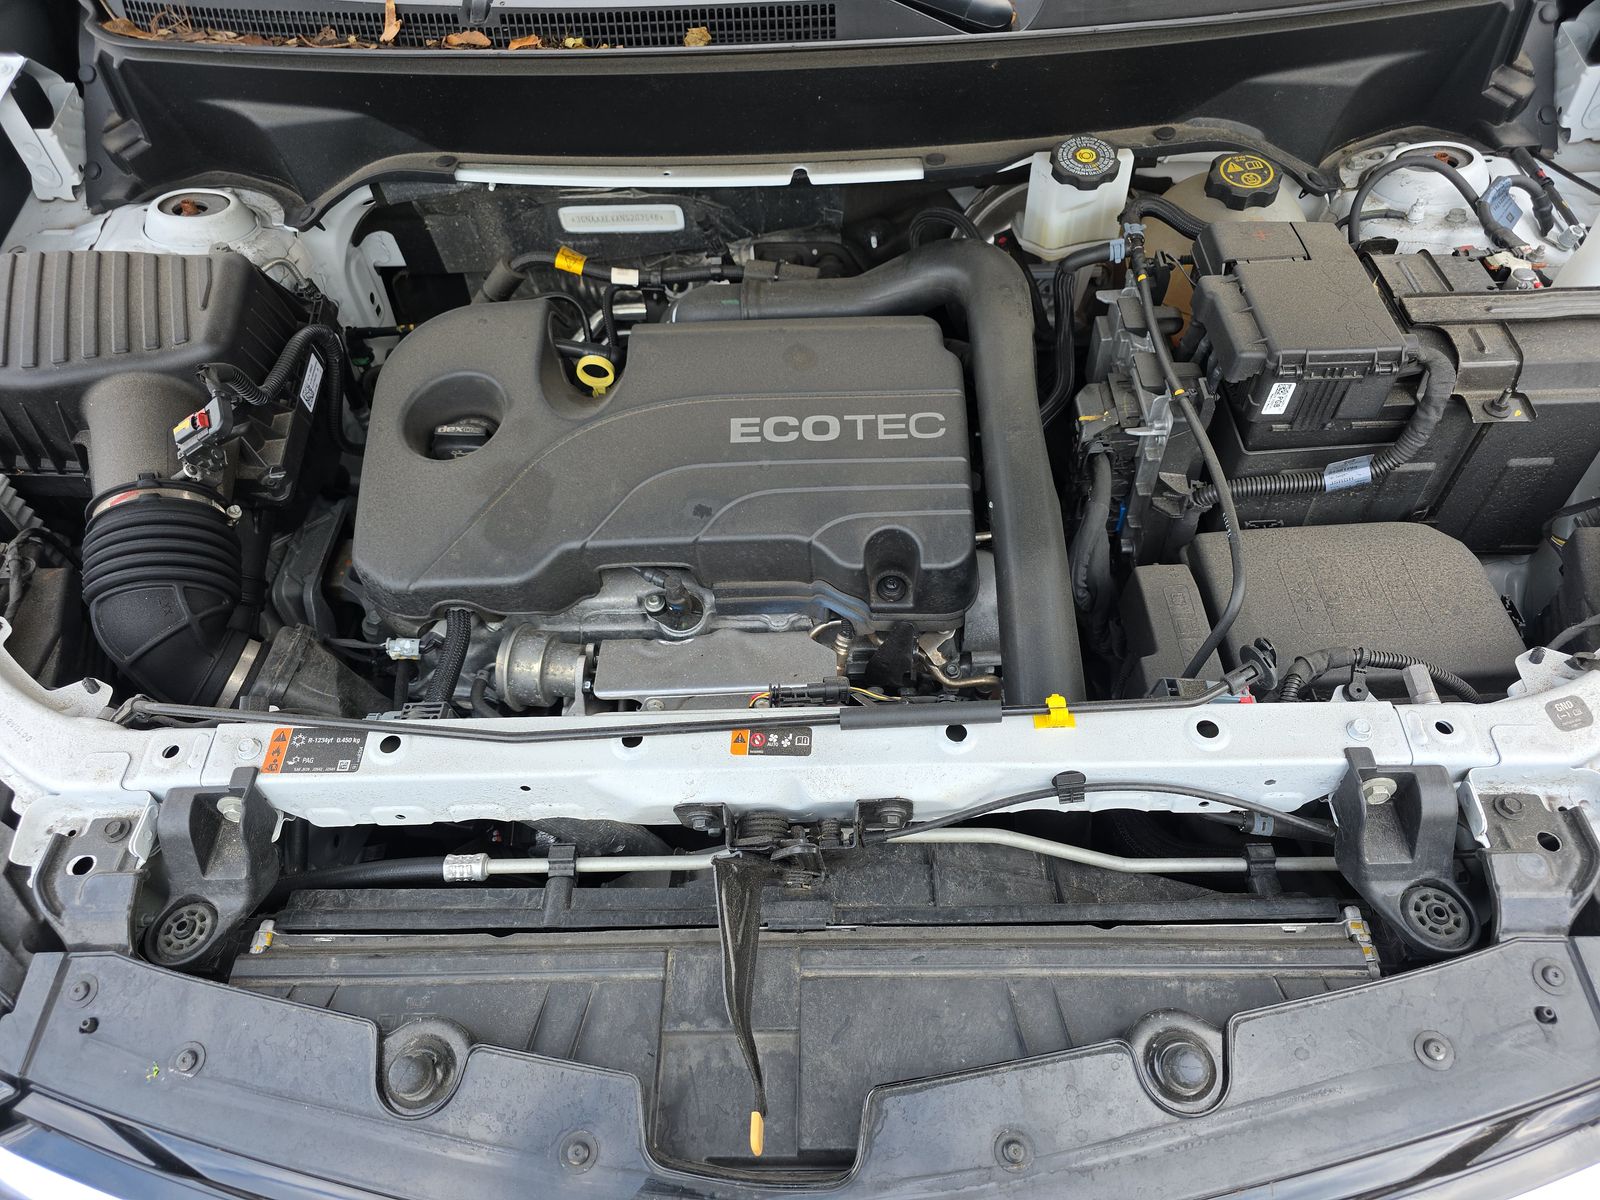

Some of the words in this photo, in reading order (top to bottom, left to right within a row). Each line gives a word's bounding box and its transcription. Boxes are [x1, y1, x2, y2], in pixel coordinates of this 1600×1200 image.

[730, 412, 946, 443] ECOTEC
[1554, 700, 1574, 711] GND
[307, 737, 334, 745] R-1234yf
[353, 737, 361, 745] kg
